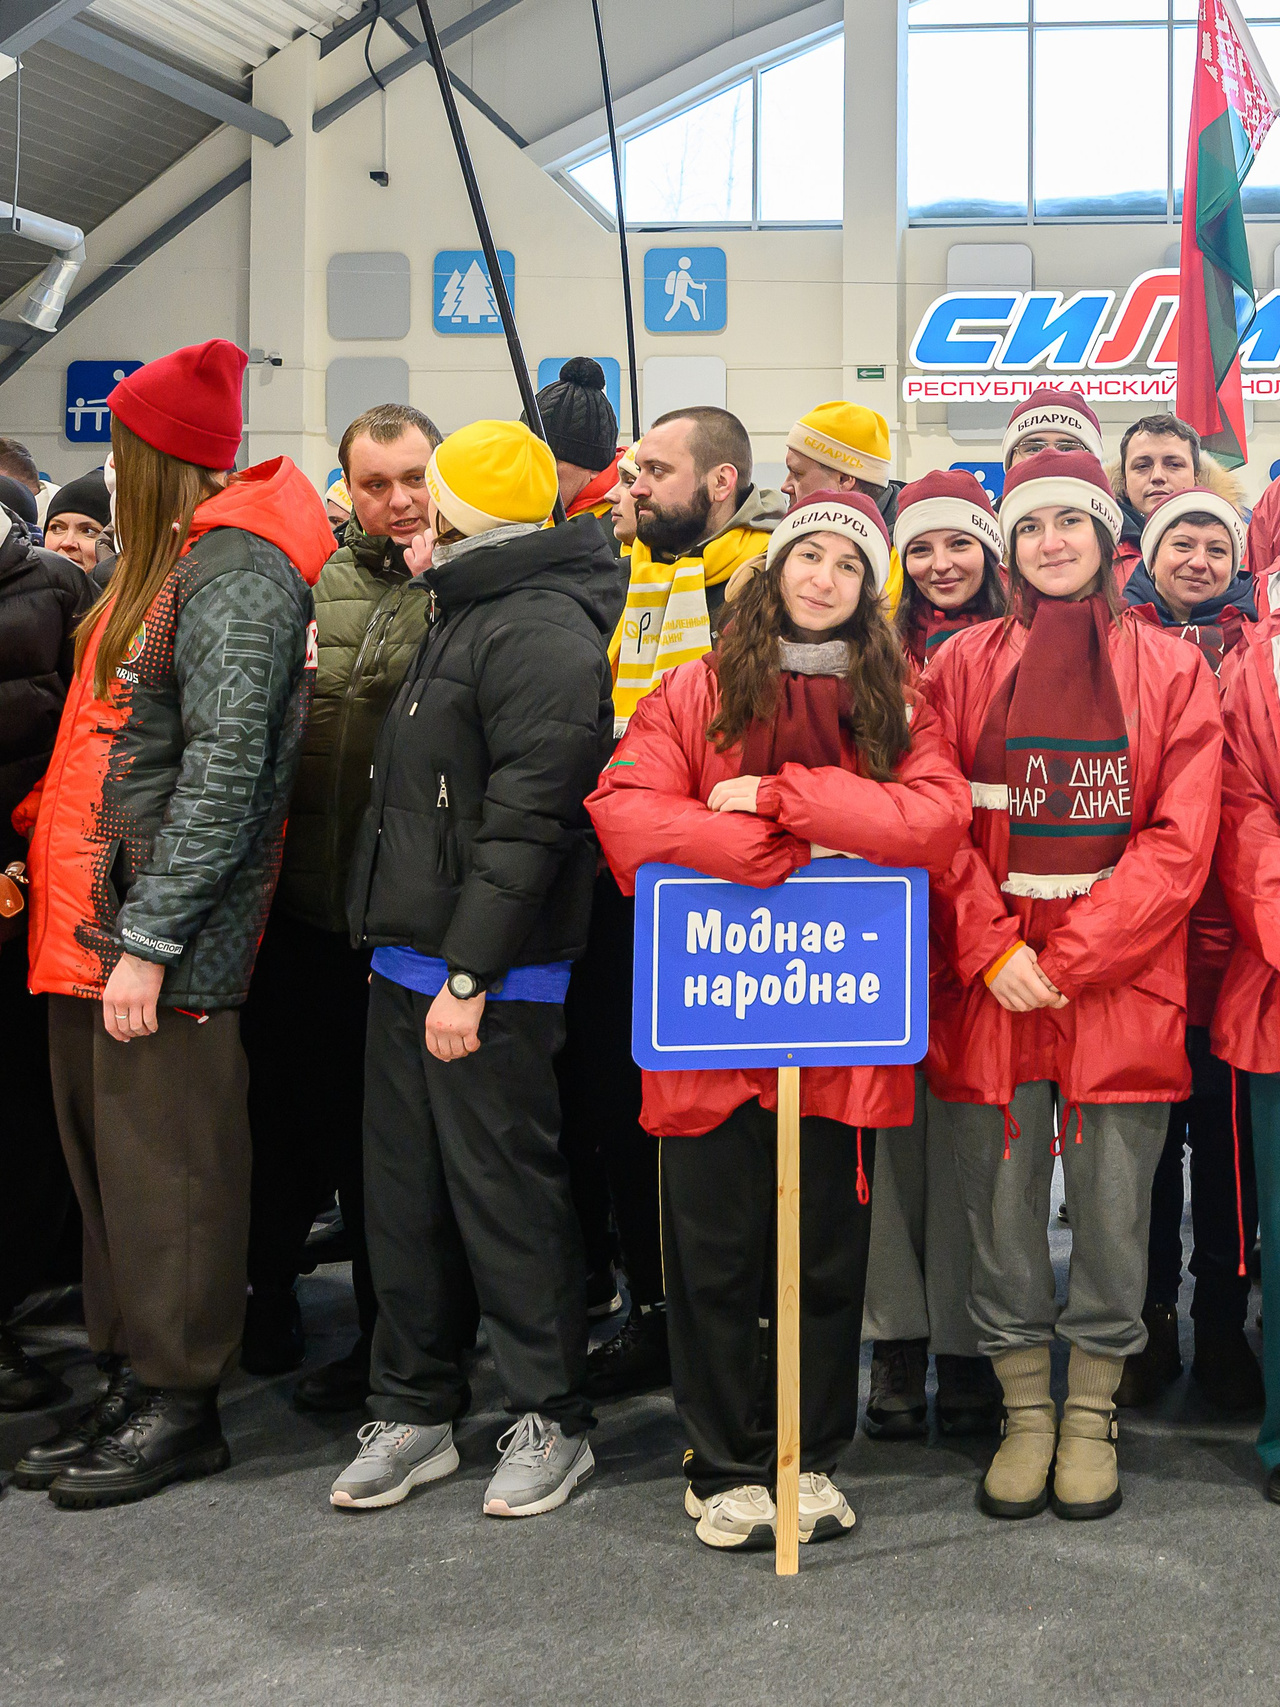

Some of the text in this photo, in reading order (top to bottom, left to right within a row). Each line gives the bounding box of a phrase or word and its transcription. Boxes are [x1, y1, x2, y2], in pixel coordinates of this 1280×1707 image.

[1017, 413, 1082, 432] БЕЛАРУСЬ
[803, 435, 865, 470] БЕЛАРУСЬ
[791, 510, 869, 538] БЕЛАРУСЬ
[686, 906, 846, 955] Моднае
[684, 958, 881, 1020] народнае
